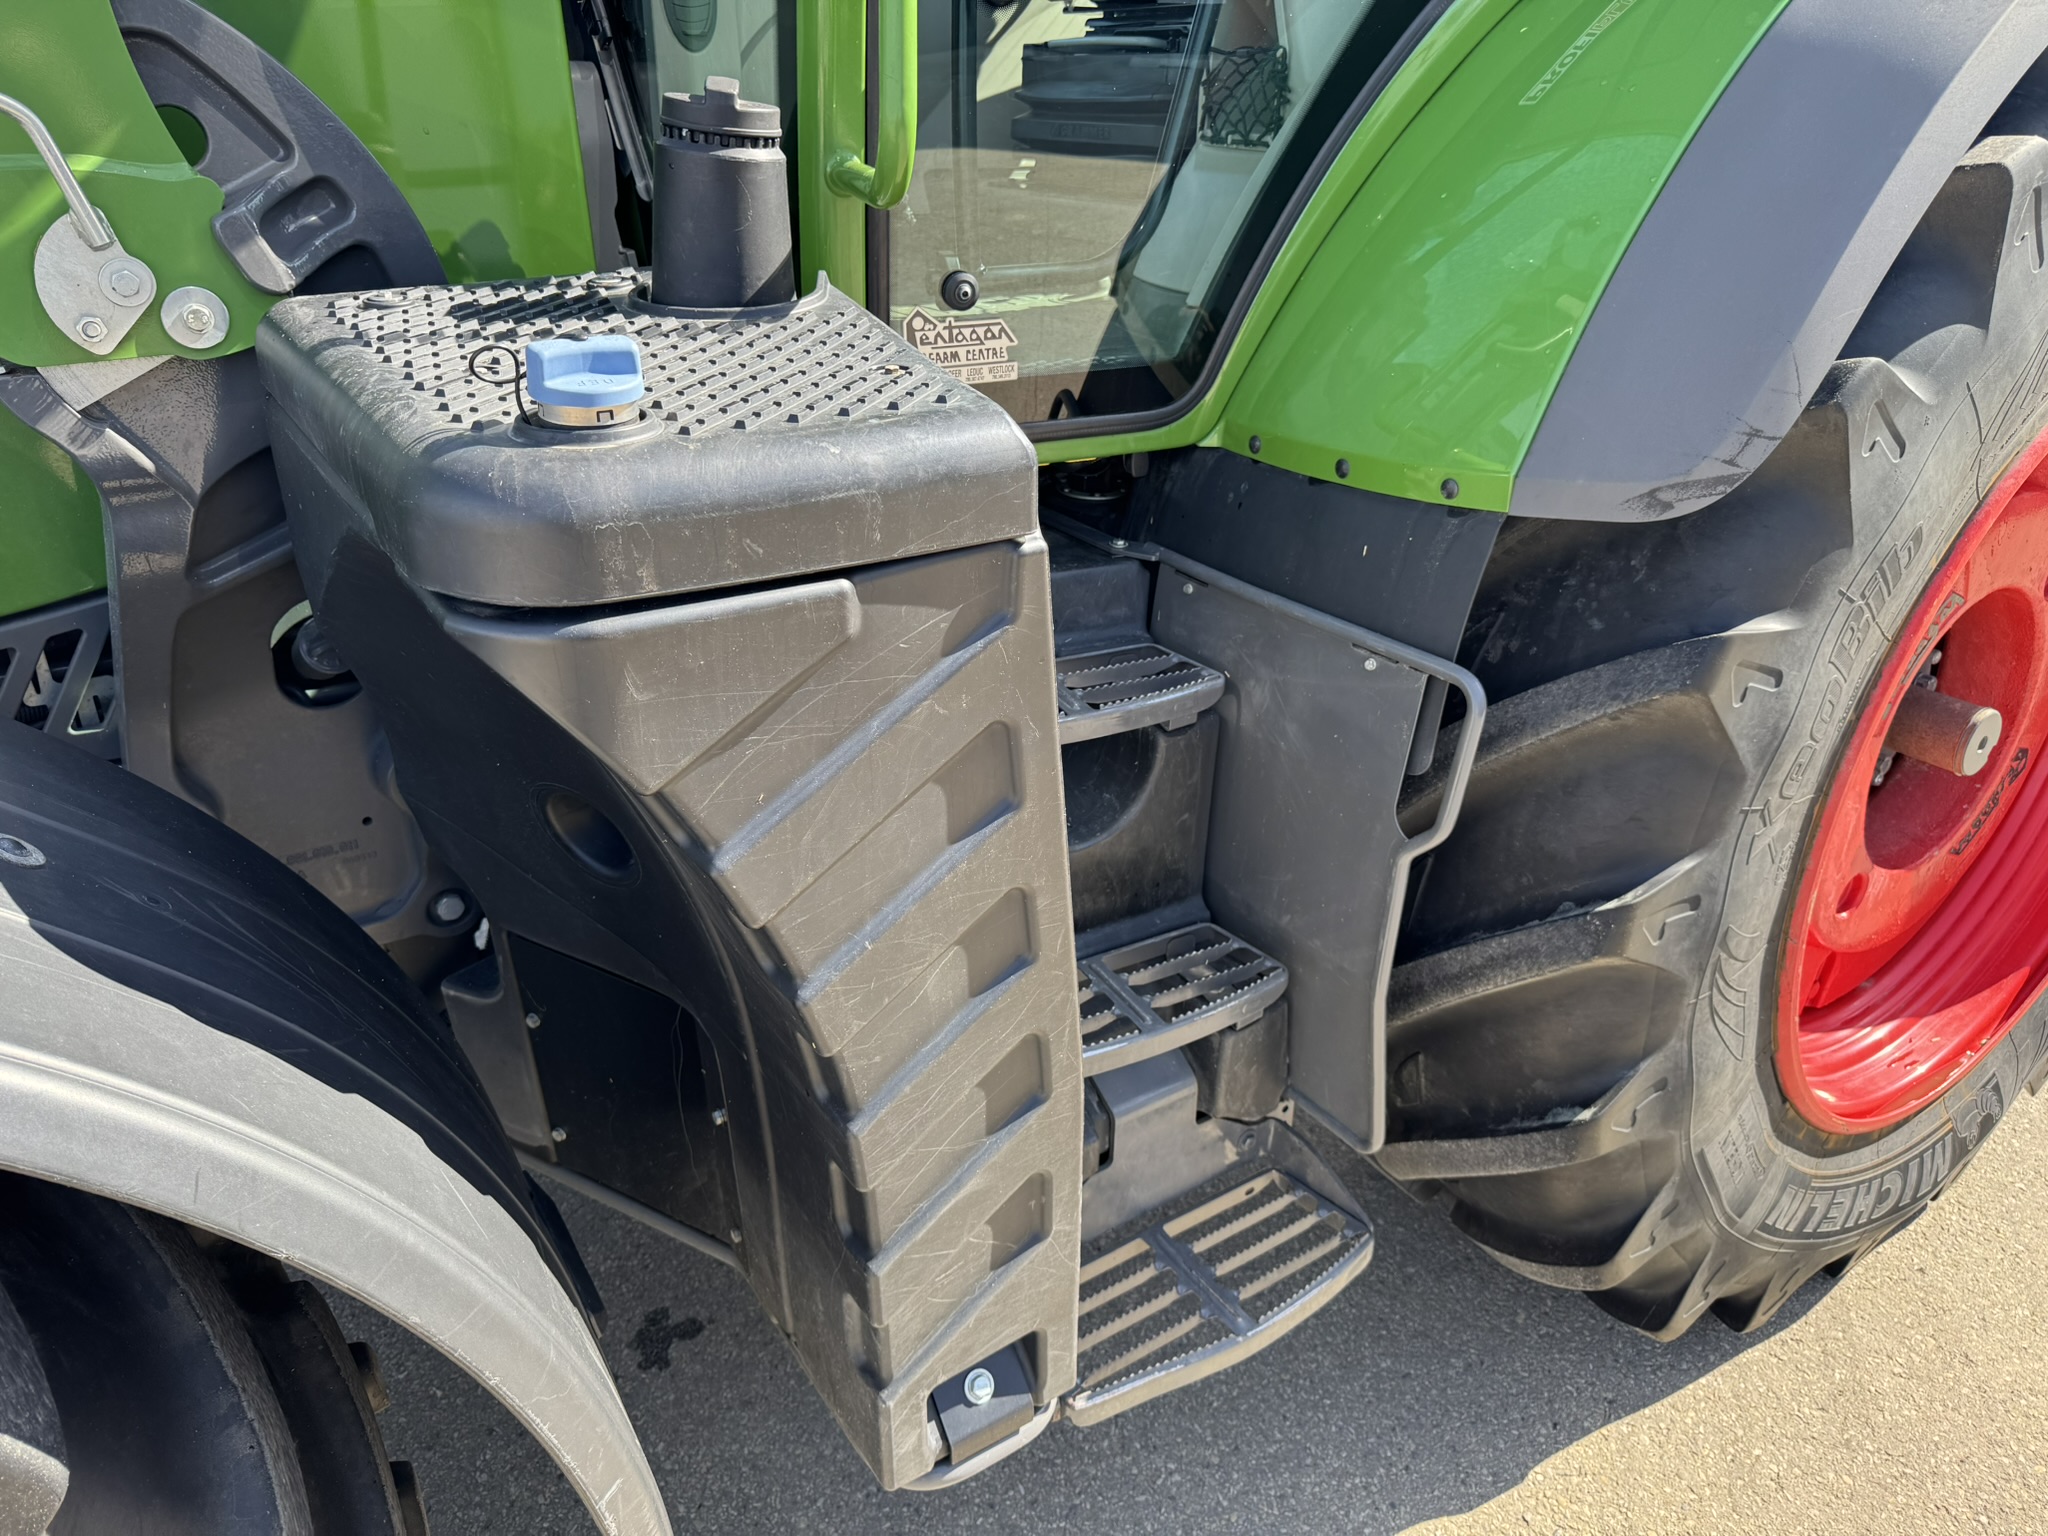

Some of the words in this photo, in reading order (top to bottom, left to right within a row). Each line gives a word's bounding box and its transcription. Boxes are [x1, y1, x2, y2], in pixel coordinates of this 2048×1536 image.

[1060, 124, 1112, 140] GRAMMER
[929, 350, 962, 365] FARM
[965, 346, 1006, 362] CENTRE
[966, 367, 984, 377] LEDUC
[988, 364, 1015, 376] WESTLOCK
[1765, 1133, 1953, 1233] MICHELIN
